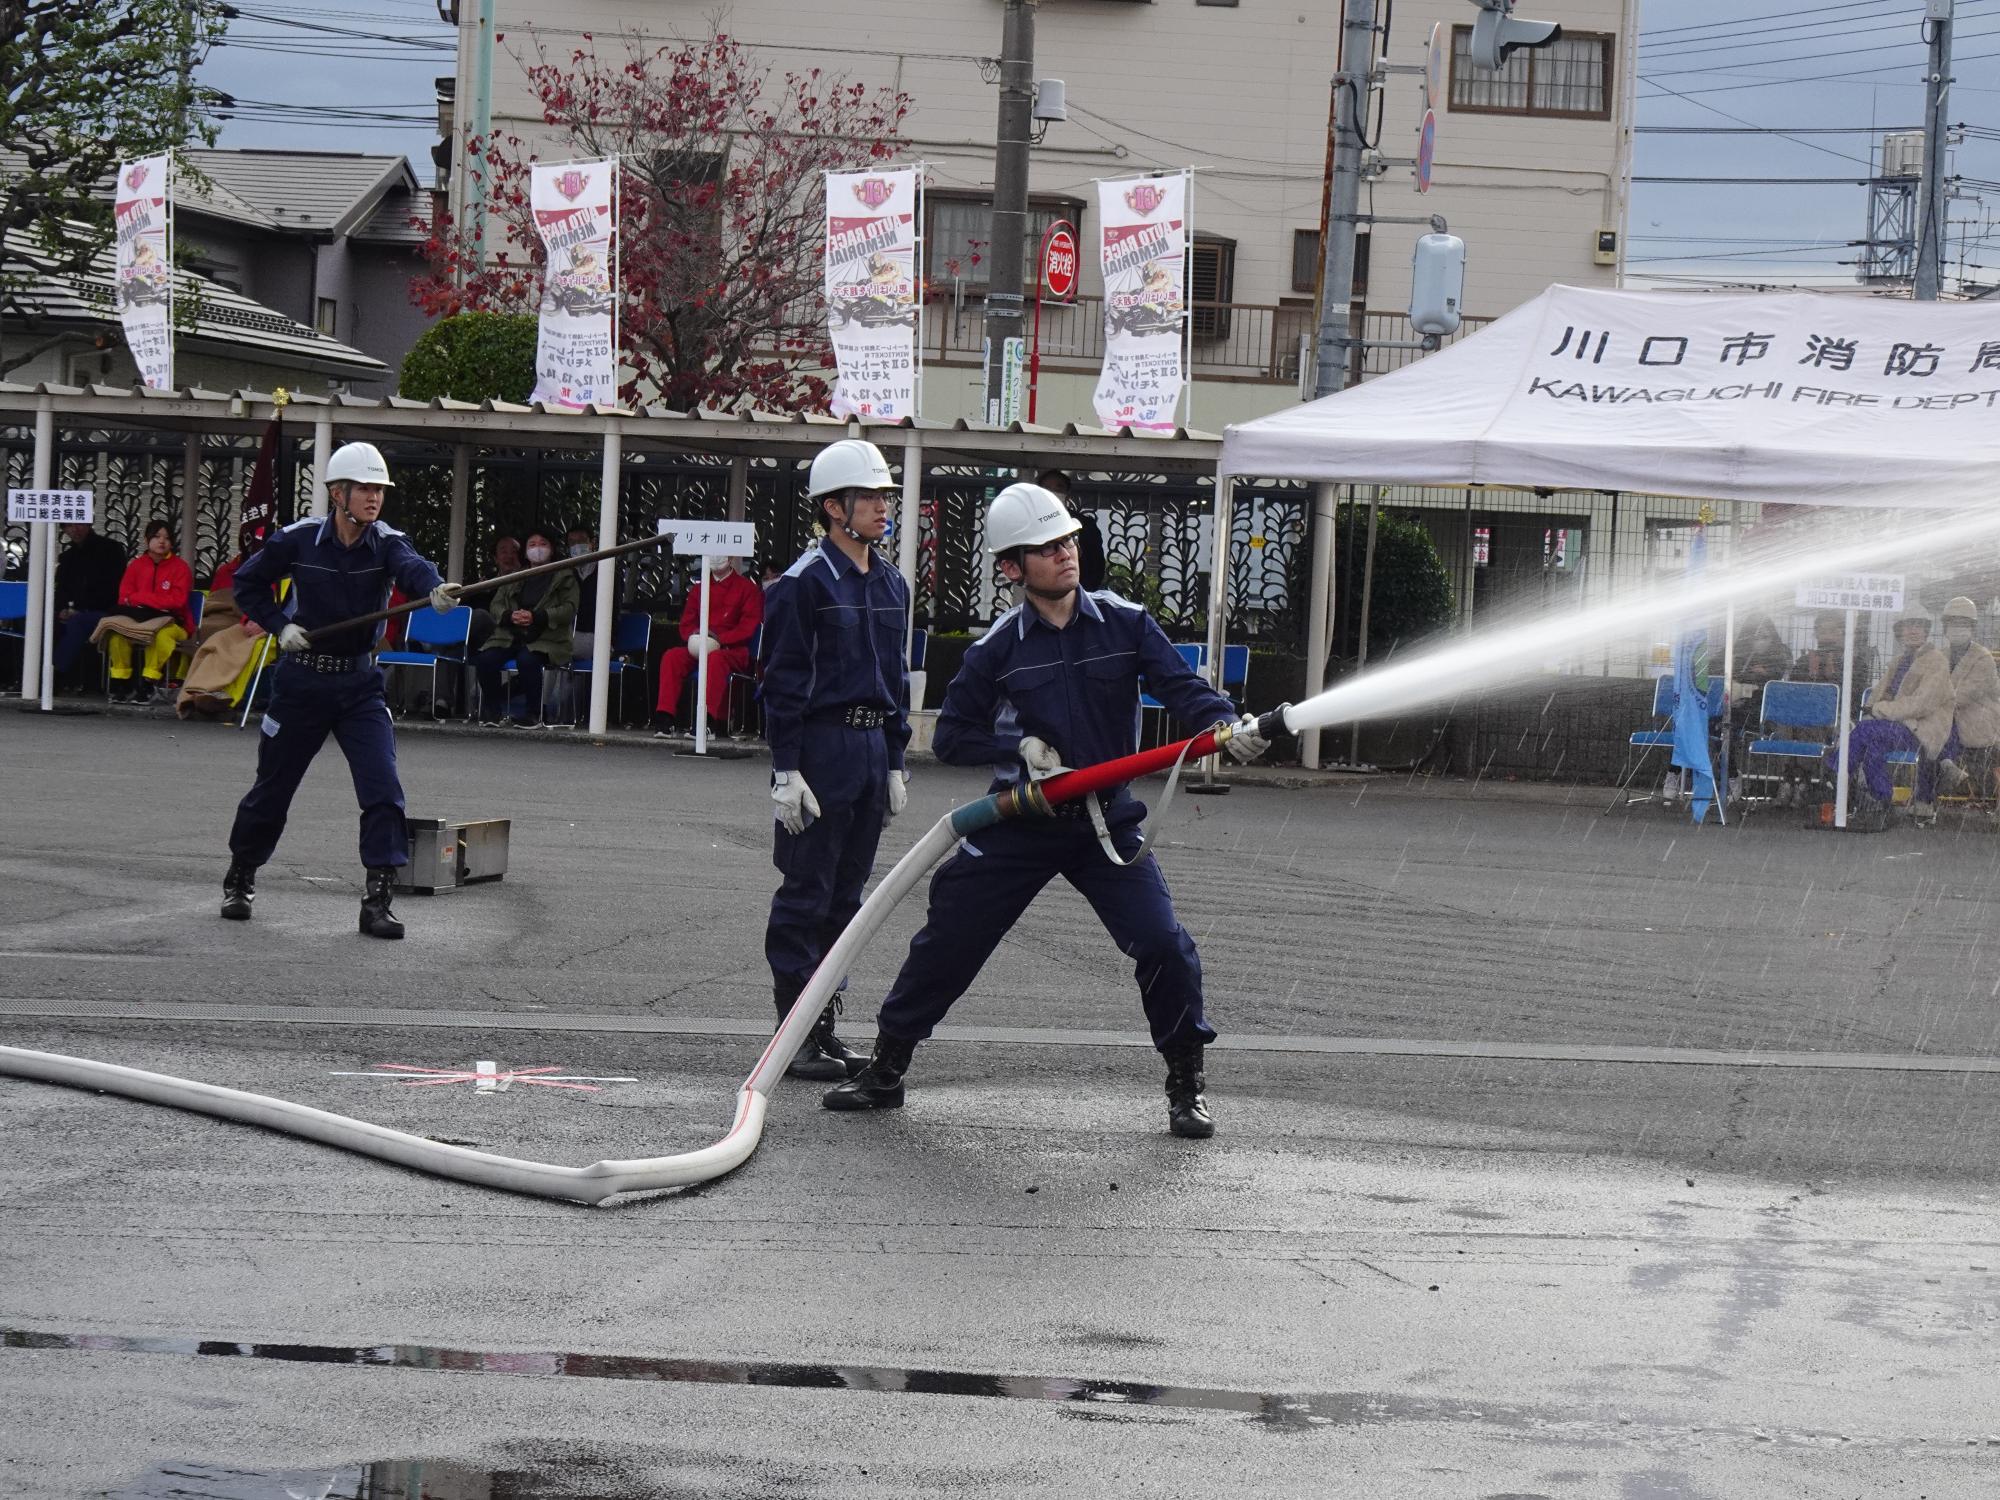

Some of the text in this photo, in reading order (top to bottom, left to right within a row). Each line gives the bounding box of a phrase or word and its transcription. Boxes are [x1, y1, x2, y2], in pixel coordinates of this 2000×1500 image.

[1049, 250, 1073, 277] 消火栓
[1527, 376, 1783, 404] KAWAGUCHI
[1792, 386, 1879, 408] FIRE
[15, 493, 87, 507] 埼玉県済生会
[15, 507, 87, 521] 川口総合病院
